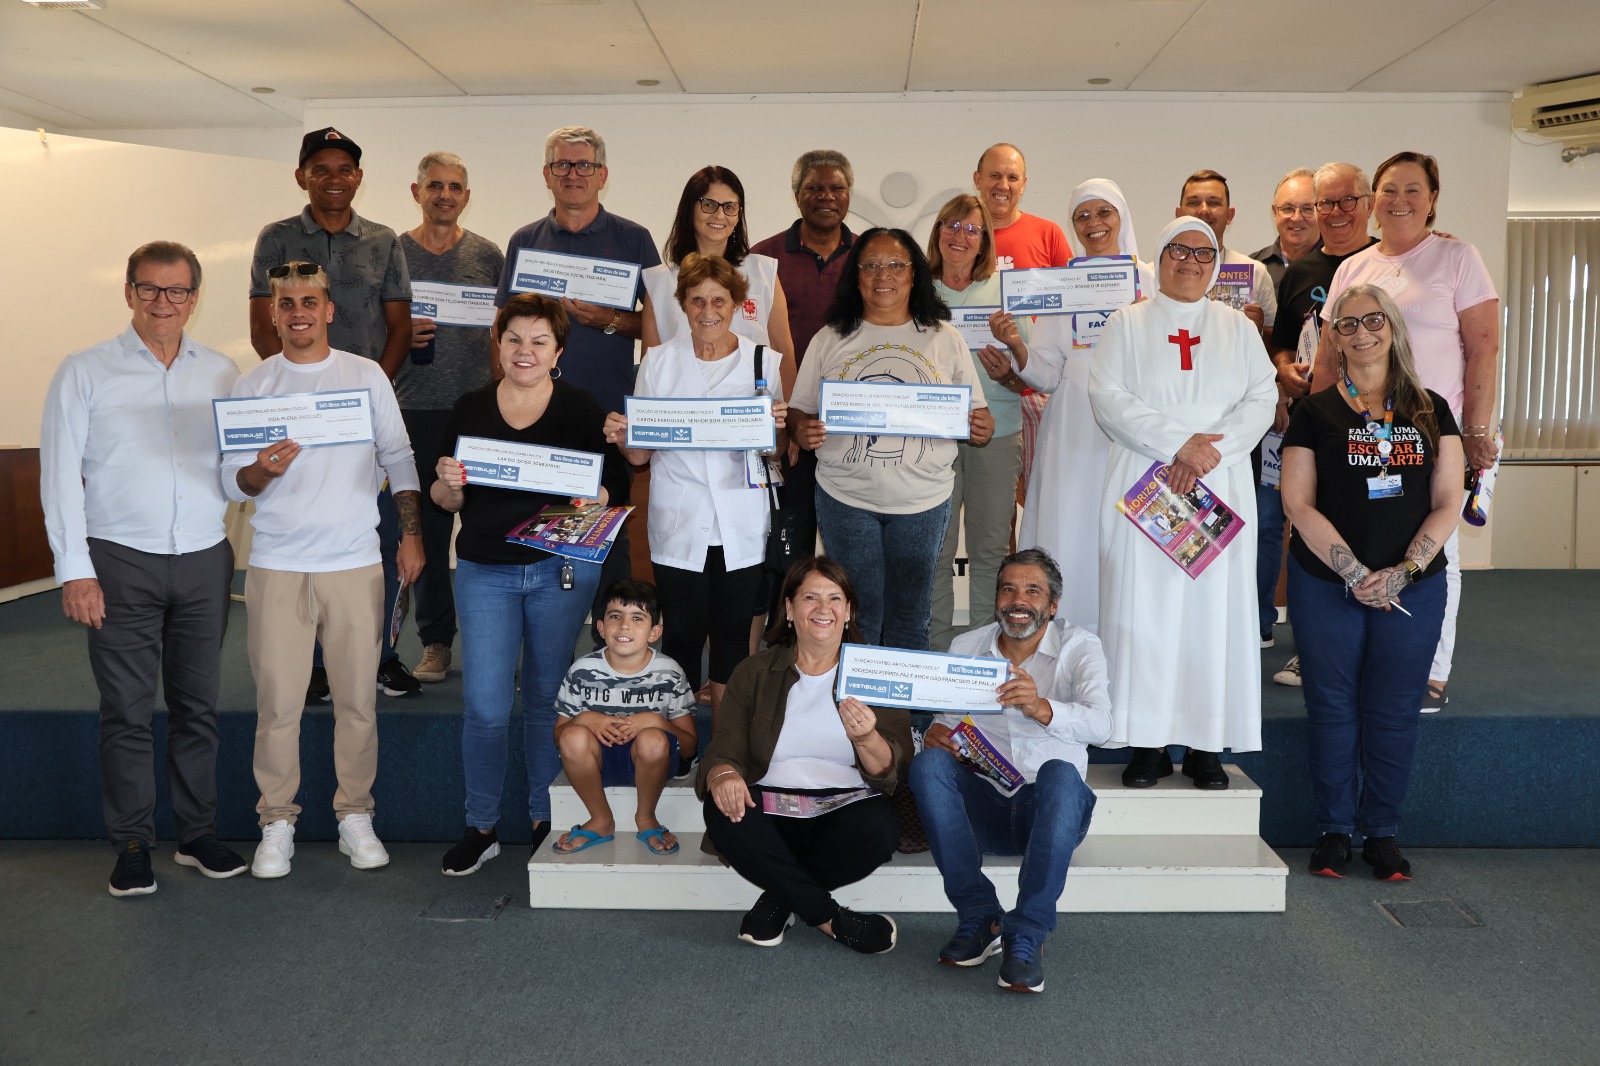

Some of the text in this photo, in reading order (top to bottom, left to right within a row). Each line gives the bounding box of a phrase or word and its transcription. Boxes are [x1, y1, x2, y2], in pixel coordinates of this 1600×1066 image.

[1263, 460, 1281, 471] FACC
[1348, 454, 1424, 466] UMA ARTE
[584, 687, 664, 703] BIG WAVE
[964, 725, 1016, 780] HORIZONTES
